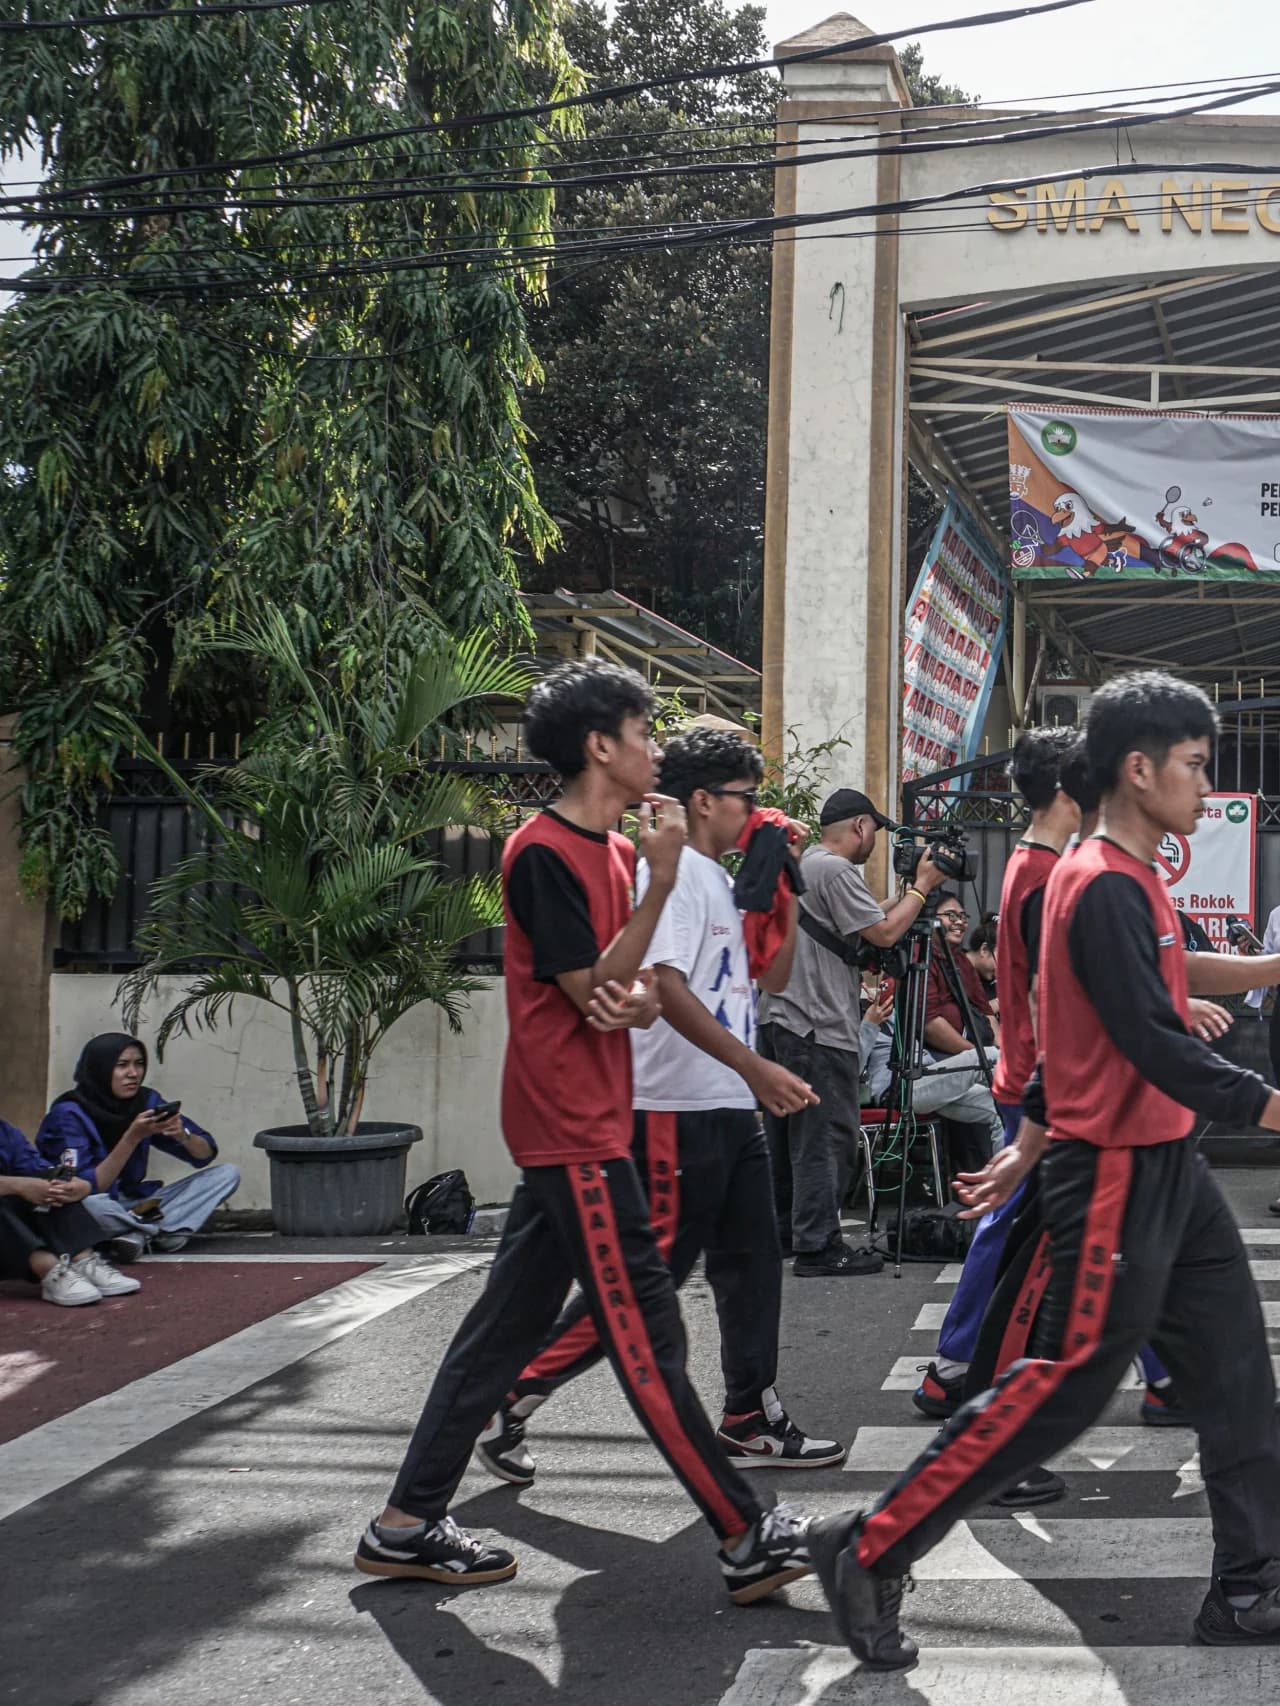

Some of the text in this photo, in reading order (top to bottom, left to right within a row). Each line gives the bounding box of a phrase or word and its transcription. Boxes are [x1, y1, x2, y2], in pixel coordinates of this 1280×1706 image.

[986, 177, 1140, 233] SMA
[1190, 893, 1235, 909] Rokok
[579, 1164, 604, 1229] SMA
